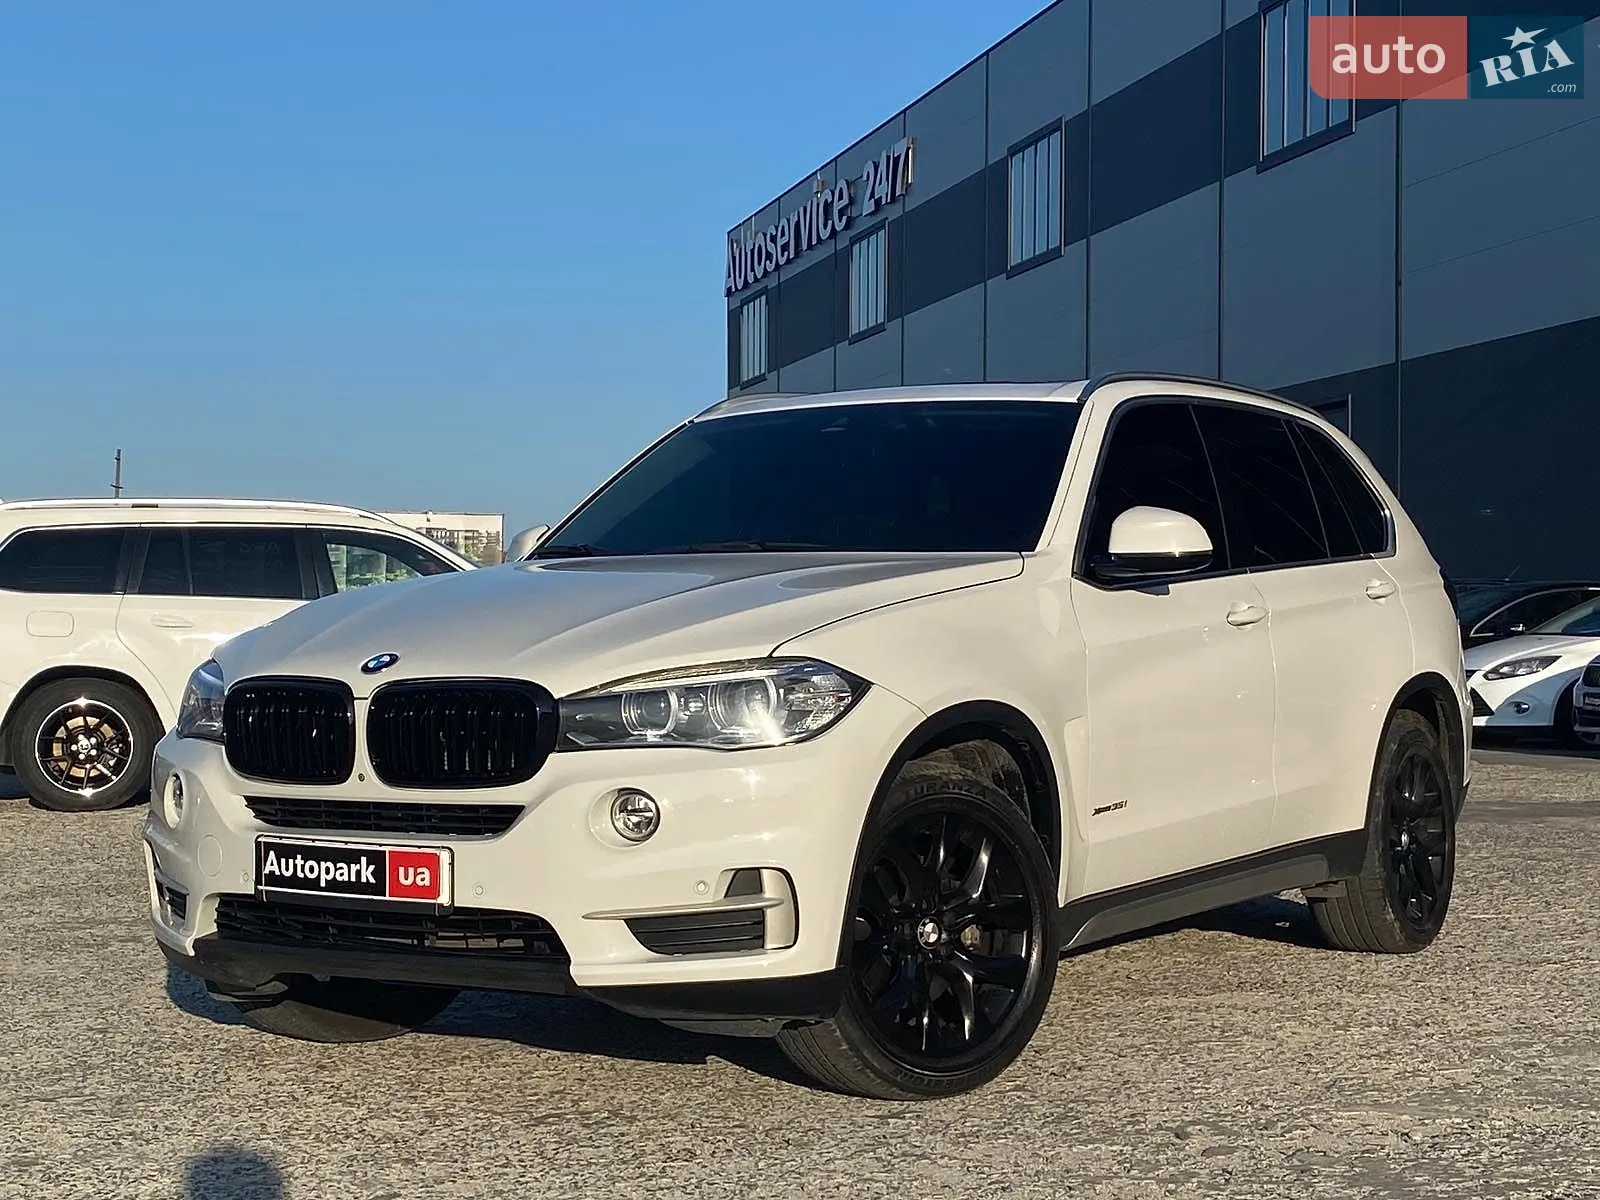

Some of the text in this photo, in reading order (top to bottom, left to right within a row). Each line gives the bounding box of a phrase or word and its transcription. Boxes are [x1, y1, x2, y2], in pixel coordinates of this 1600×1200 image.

[726, 137, 912, 292] Autoservice 24/7
[263, 850, 431, 887] Autopark ua
